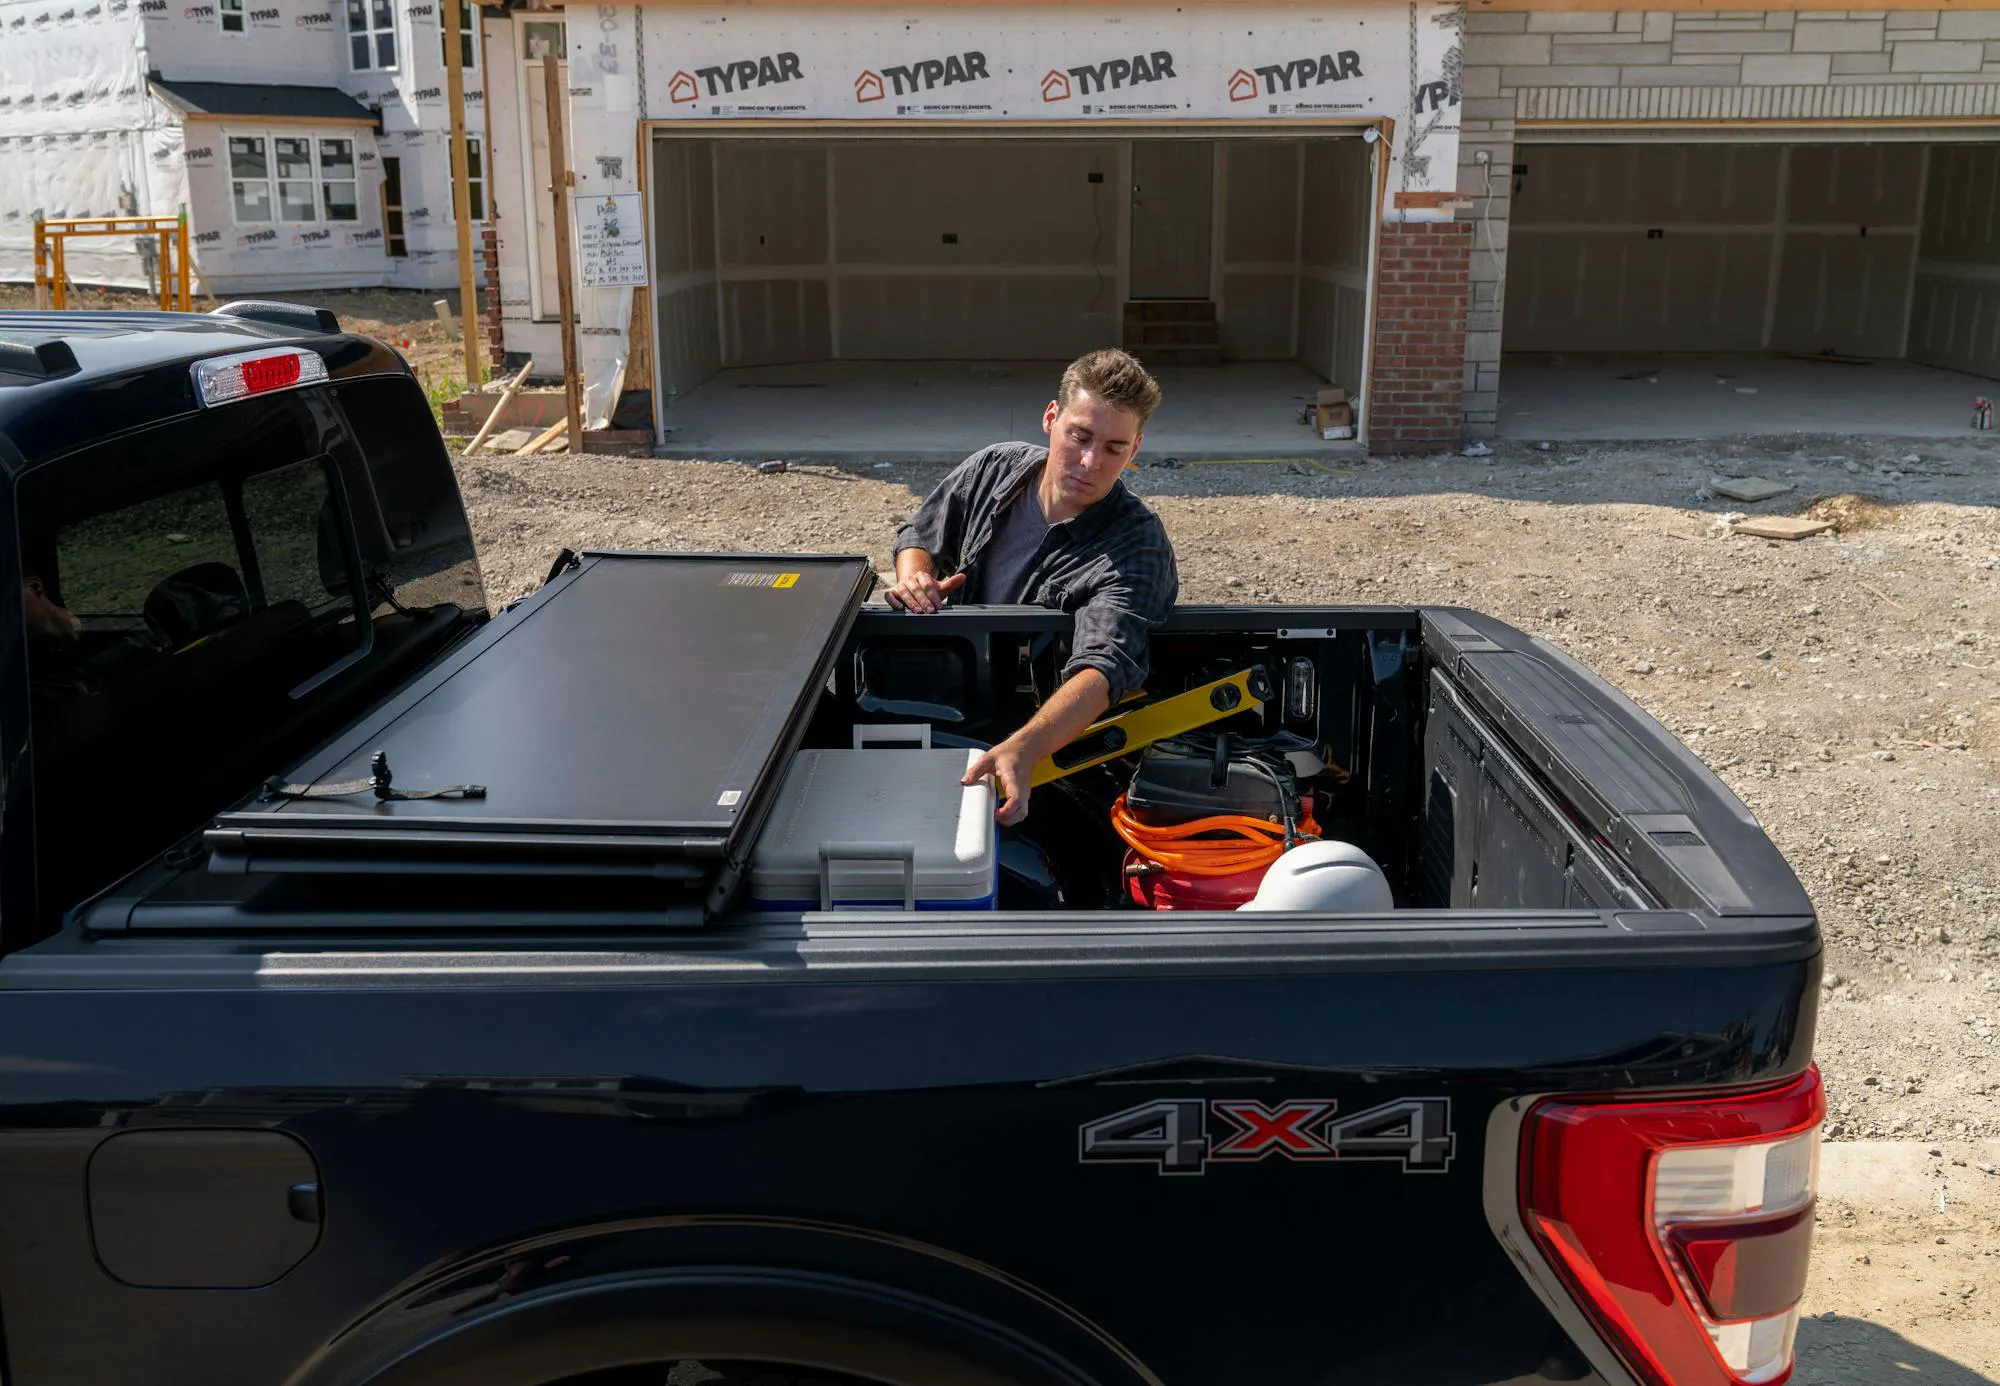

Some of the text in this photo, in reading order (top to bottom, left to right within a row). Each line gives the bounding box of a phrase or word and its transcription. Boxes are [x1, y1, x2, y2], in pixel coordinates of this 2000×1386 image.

[302, 12, 333, 26] TYPAR
[694, 51, 804, 96] TYPAR
[880, 51, 990, 96] TYPAR
[1067, 50, 1177, 96] TYPAR
[1254, 50, 1363, 95] TYPAR
[245, 229, 277, 244] TYPAR
